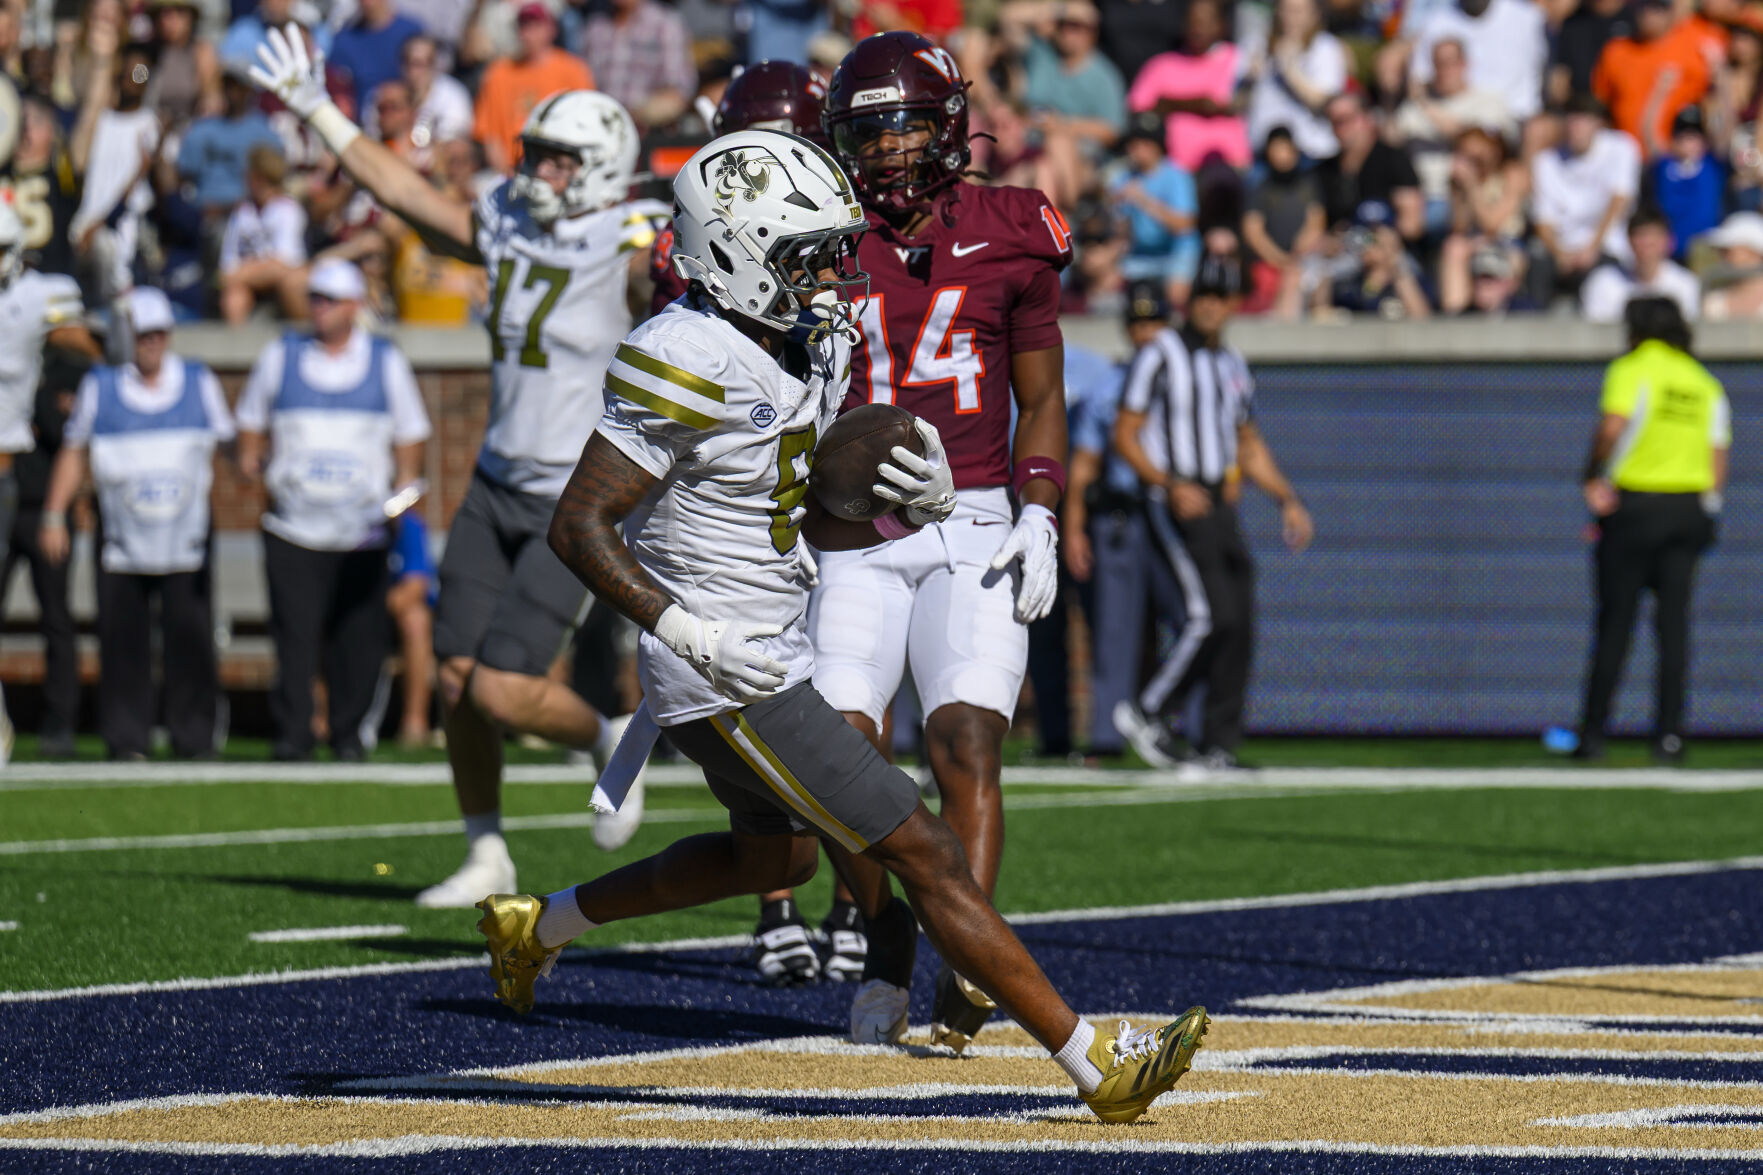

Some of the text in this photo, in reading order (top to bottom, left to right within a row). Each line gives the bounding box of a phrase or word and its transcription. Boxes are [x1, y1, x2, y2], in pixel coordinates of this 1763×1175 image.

[861, 92, 887, 102] TECH
[894, 247, 929, 264] VT
[490, 259, 571, 368] 17
[855, 286, 986, 415] 14
[754, 408, 773, 418] ACC
